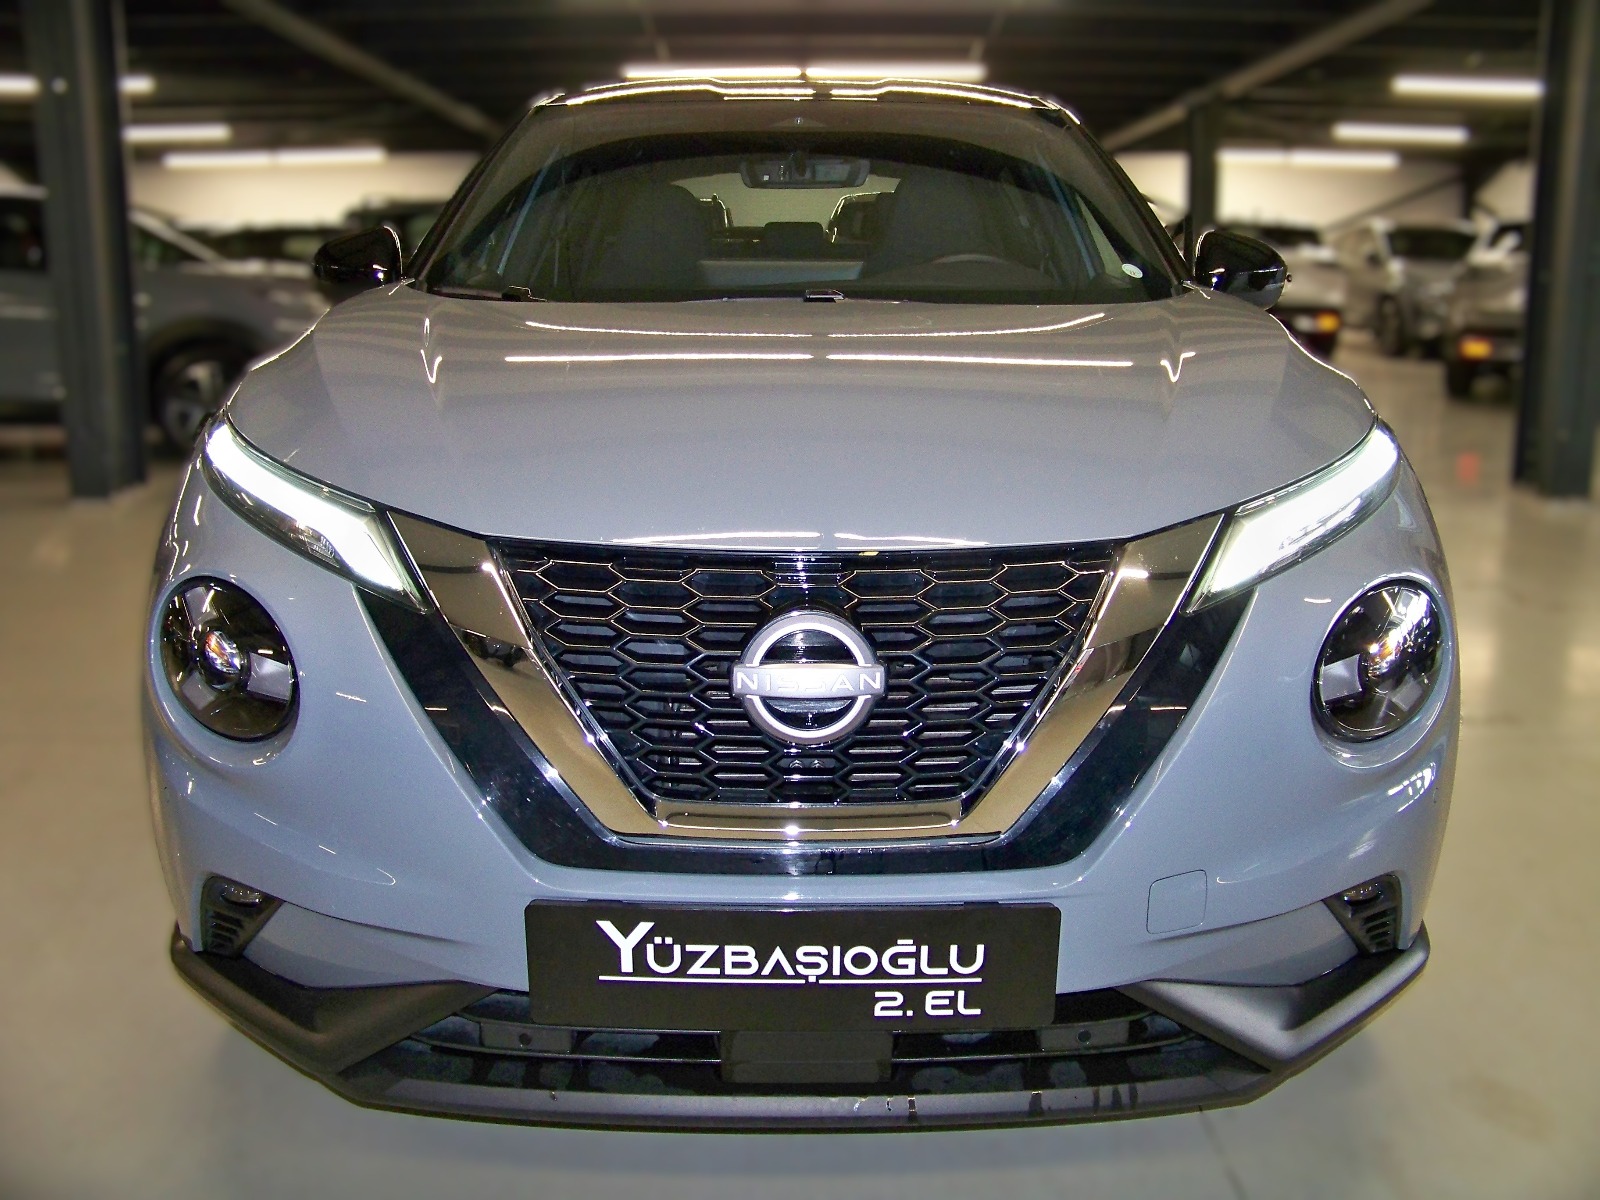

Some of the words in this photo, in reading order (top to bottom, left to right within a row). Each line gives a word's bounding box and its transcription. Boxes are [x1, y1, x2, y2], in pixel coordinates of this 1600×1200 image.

[736, 671, 881, 692] NISSAN
[596, 920, 985, 983] YÜZBAŞIOĞLU
[873, 991, 914, 1017] 2.
[925, 990, 982, 1016] EL
